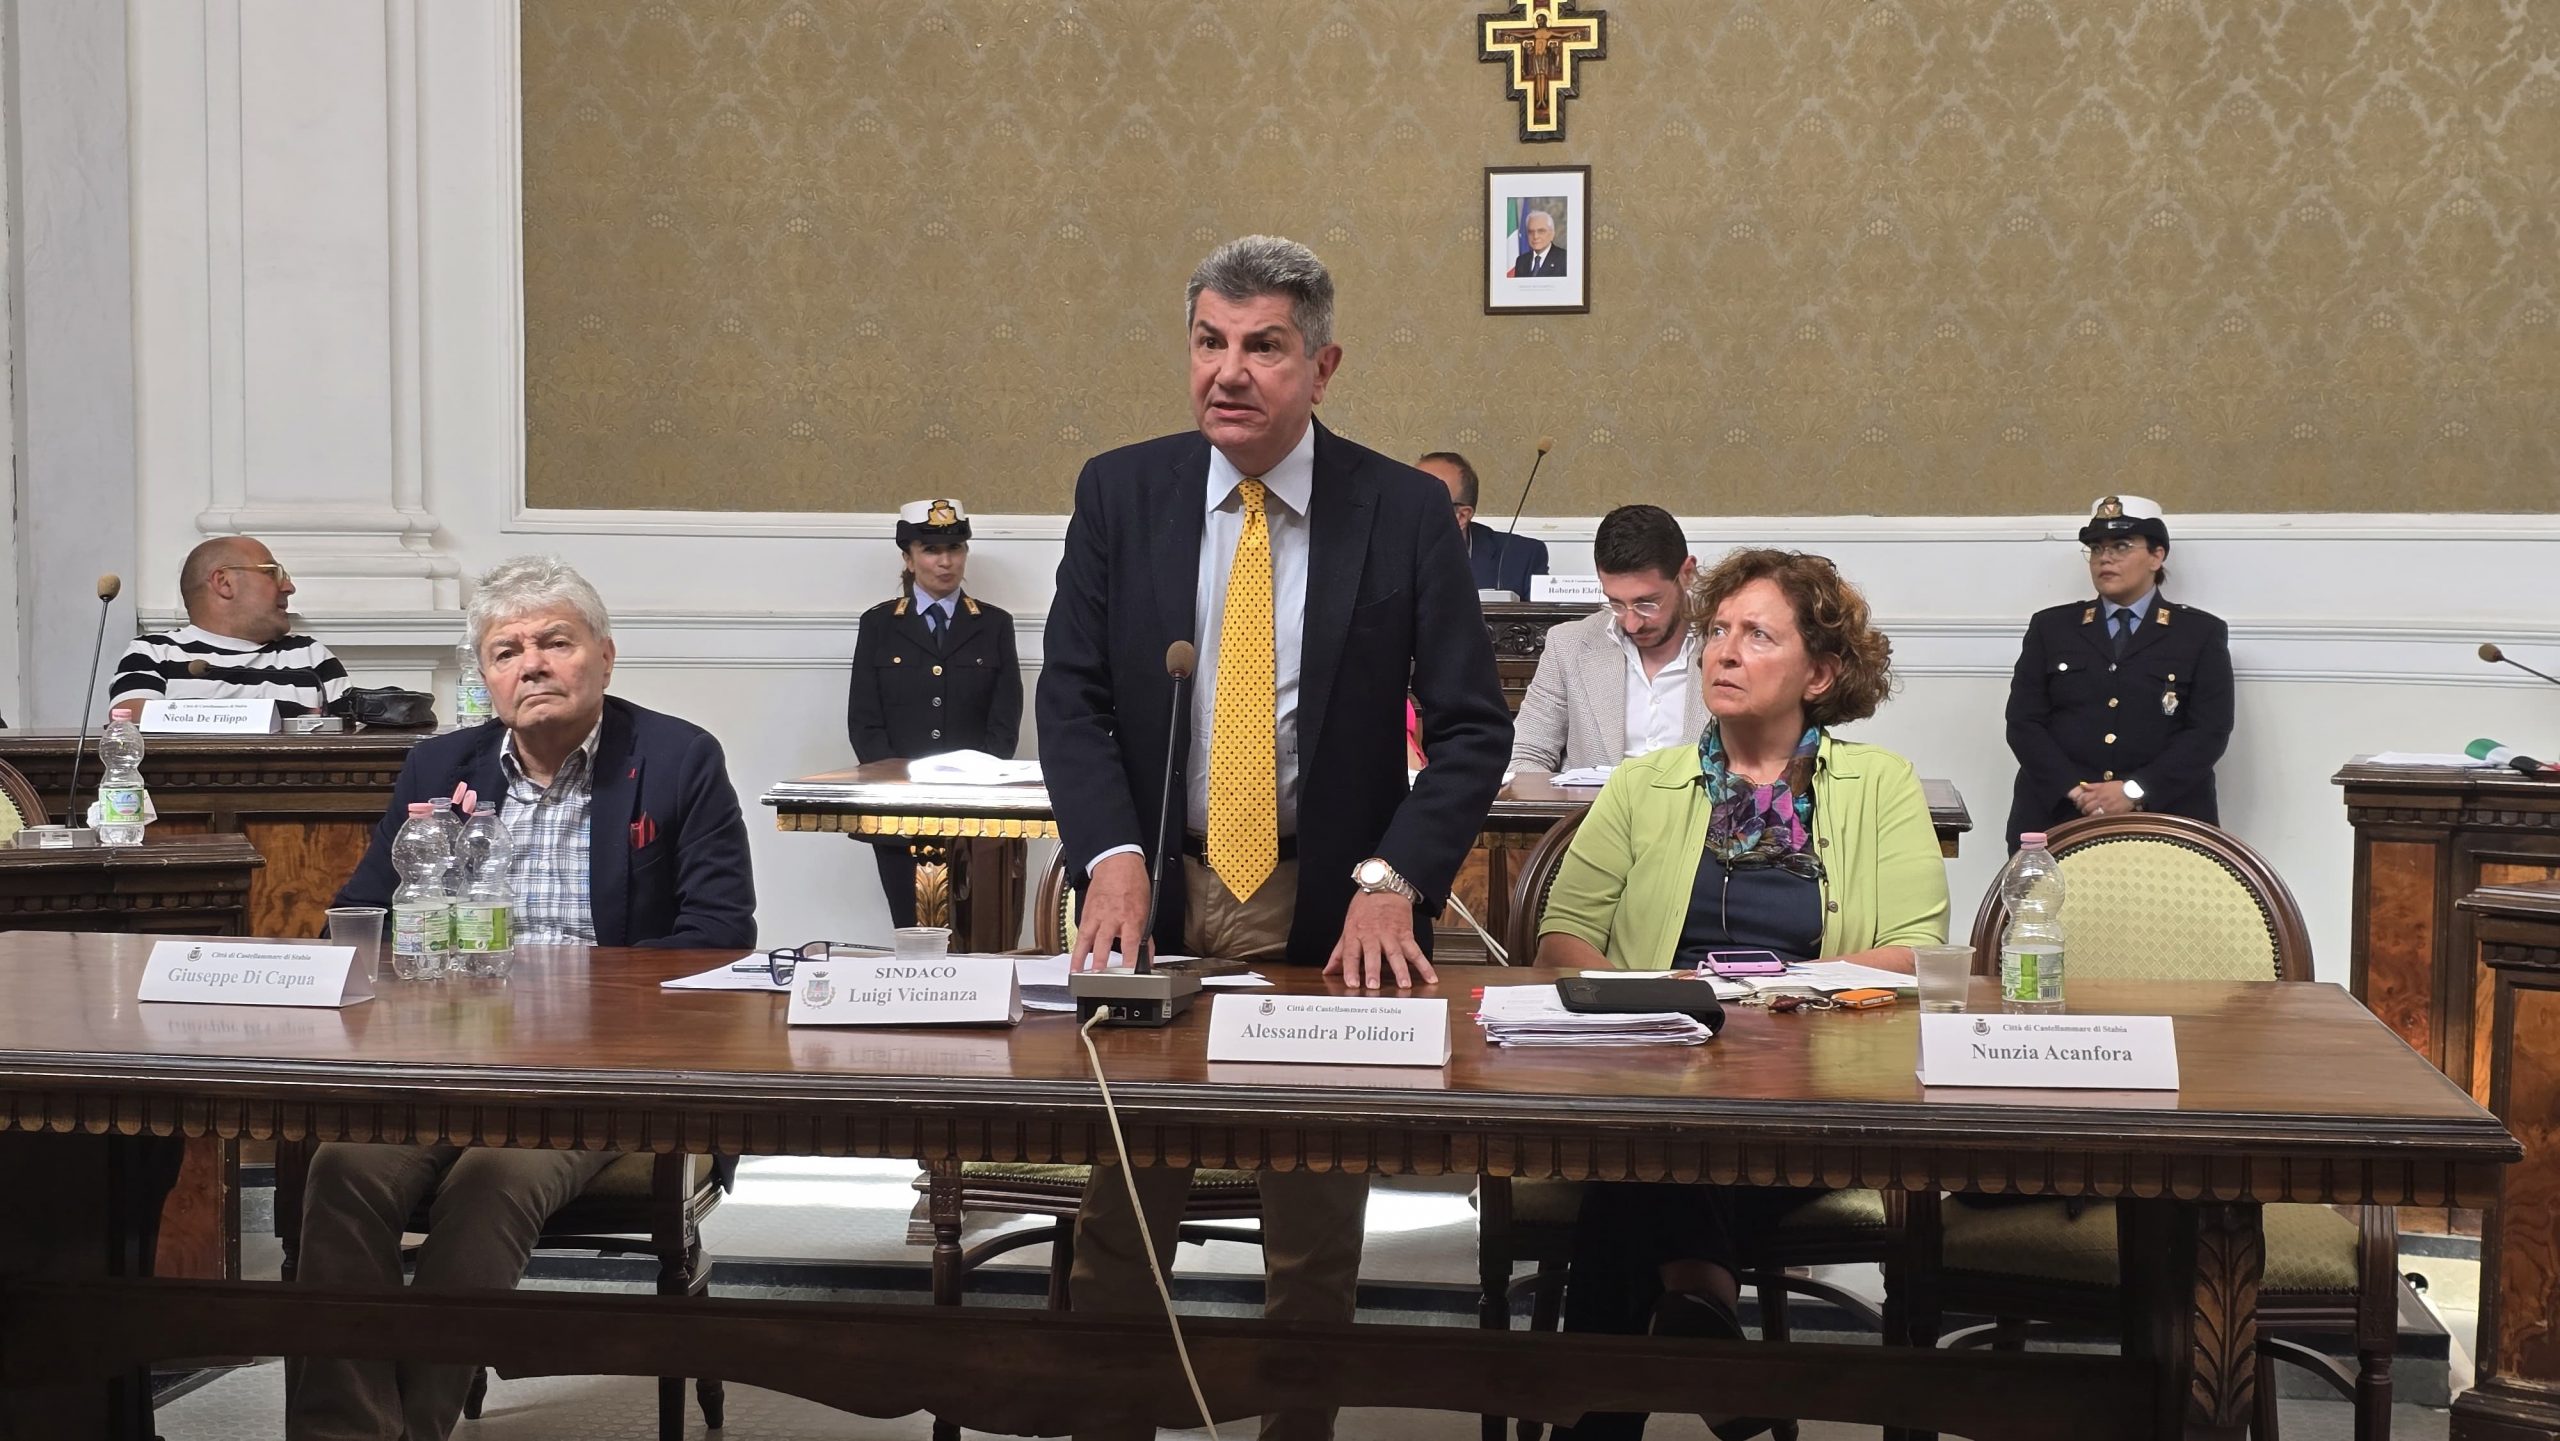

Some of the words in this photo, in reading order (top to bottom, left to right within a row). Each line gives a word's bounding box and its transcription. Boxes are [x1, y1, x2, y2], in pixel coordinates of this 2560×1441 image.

[163, 713, 194, 722] Nicola
[197, 714, 211, 722] De
[213, 714, 248, 724] Filippo
[167, 968, 239, 987] Giuseppe
[243, 970, 261, 985] Di
[265, 970, 315, 989] Capua
[875, 967, 956, 979] SINDACO
[848, 988, 892, 1006] Luigi
[897, 987, 978, 1002] Vicinanza
[1370, 1006, 1378, 1014] di
[1240, 1023, 1338, 1040] Alessandra
[1344, 1024, 1415, 1042] Polidori
[2002, 1023, 2022, 1032] Città
[2023, 1024, 2032, 1032] di
[2033, 1024, 2092, 1033] Castellammare
[2093, 1024, 2102, 1033] di
[2103, 1024, 2128, 1033] Stabia
[1972, 1043, 2039, 1061] Nunzia
[2044, 1044, 2133, 1062] Acanfora
